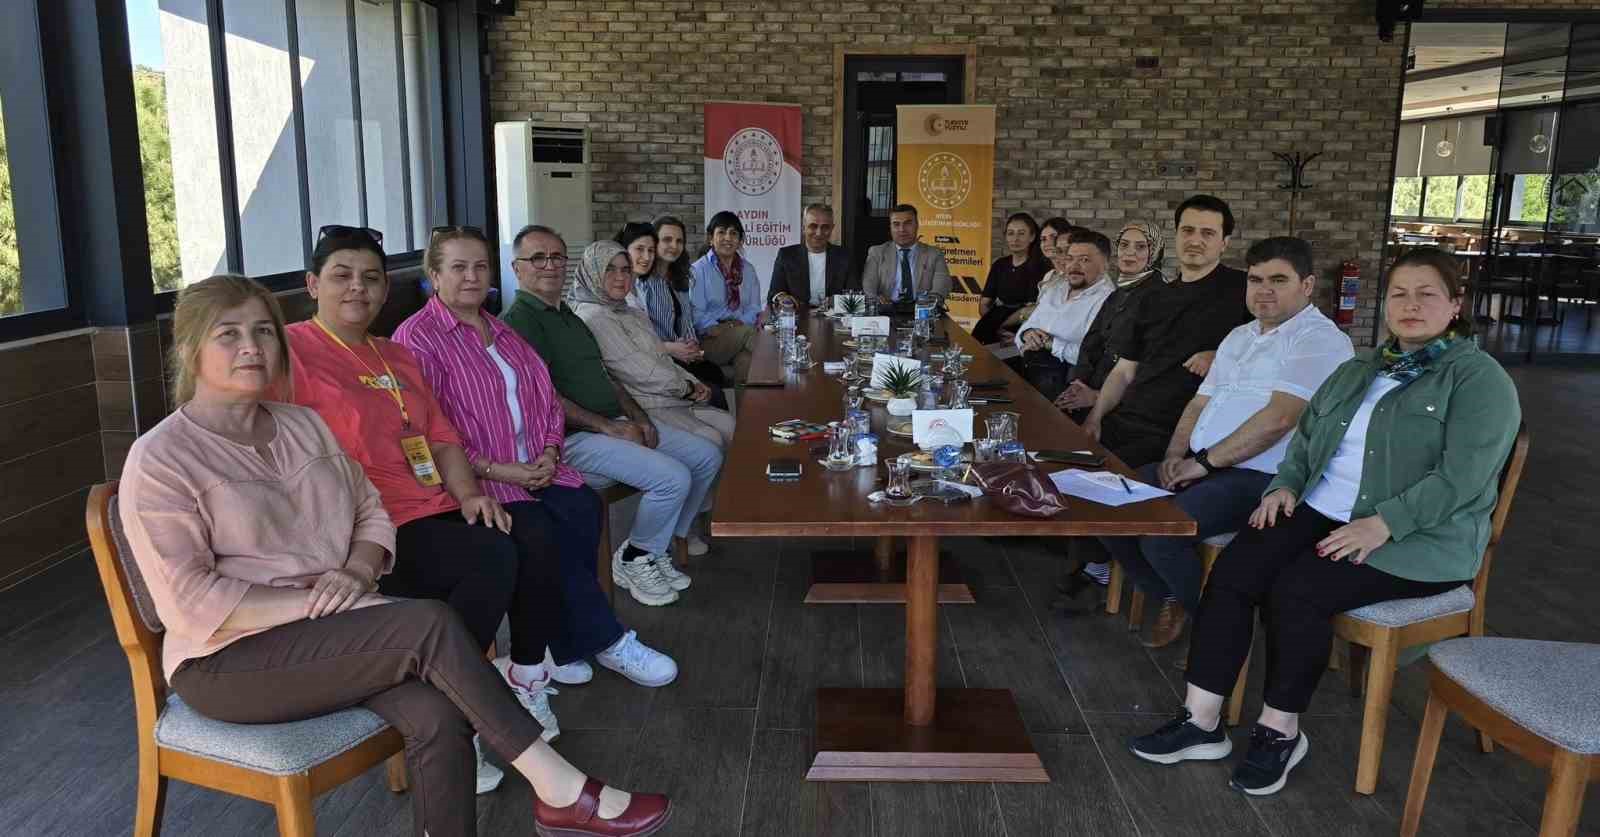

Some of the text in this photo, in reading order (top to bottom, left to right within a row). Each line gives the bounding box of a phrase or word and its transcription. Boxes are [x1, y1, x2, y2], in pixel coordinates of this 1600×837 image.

[737, 209, 769, 219] AYDIN
[757, 221, 791, 233] EĞİTİM
[745, 235, 786, 246] ÜRLÜĞÜ
